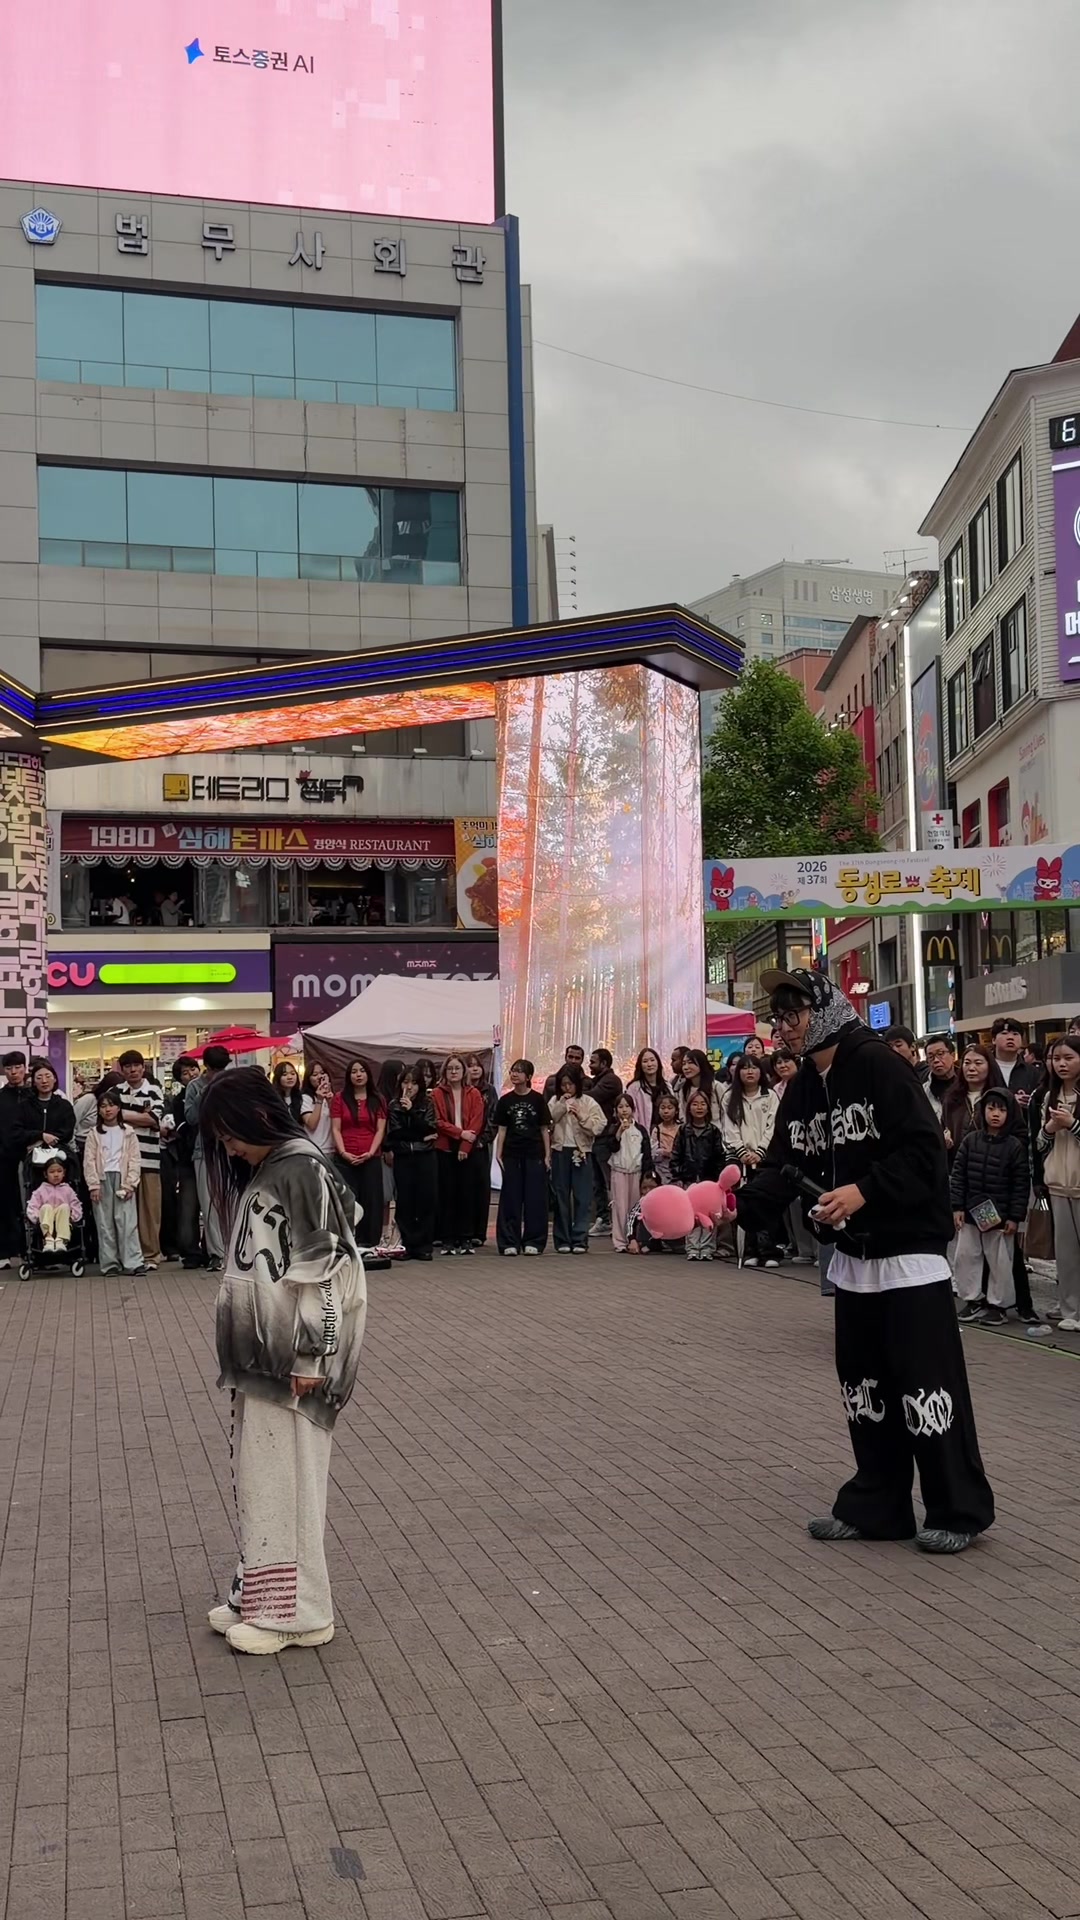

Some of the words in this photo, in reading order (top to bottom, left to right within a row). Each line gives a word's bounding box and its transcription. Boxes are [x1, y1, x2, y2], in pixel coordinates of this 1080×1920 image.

[212, 45, 289, 72] 토스증권
[292, 54, 315, 74] AI
[114, 212, 487, 284] 법무사회관
[830, 586, 873, 605] 삼성생명
[88, 826, 156, 847] 1980
[177, 826, 309, 850] 심해돈까스
[313, 838, 347, 850] 경양식
[349, 839, 431, 851] RESTAURANT
[797, 861, 827, 873] 2026
[797, 874, 827, 885] 제37회
[834, 868, 924, 905] 동성로
[925, 865, 981, 900] 축제
[47, 961, 96, 987] CU
